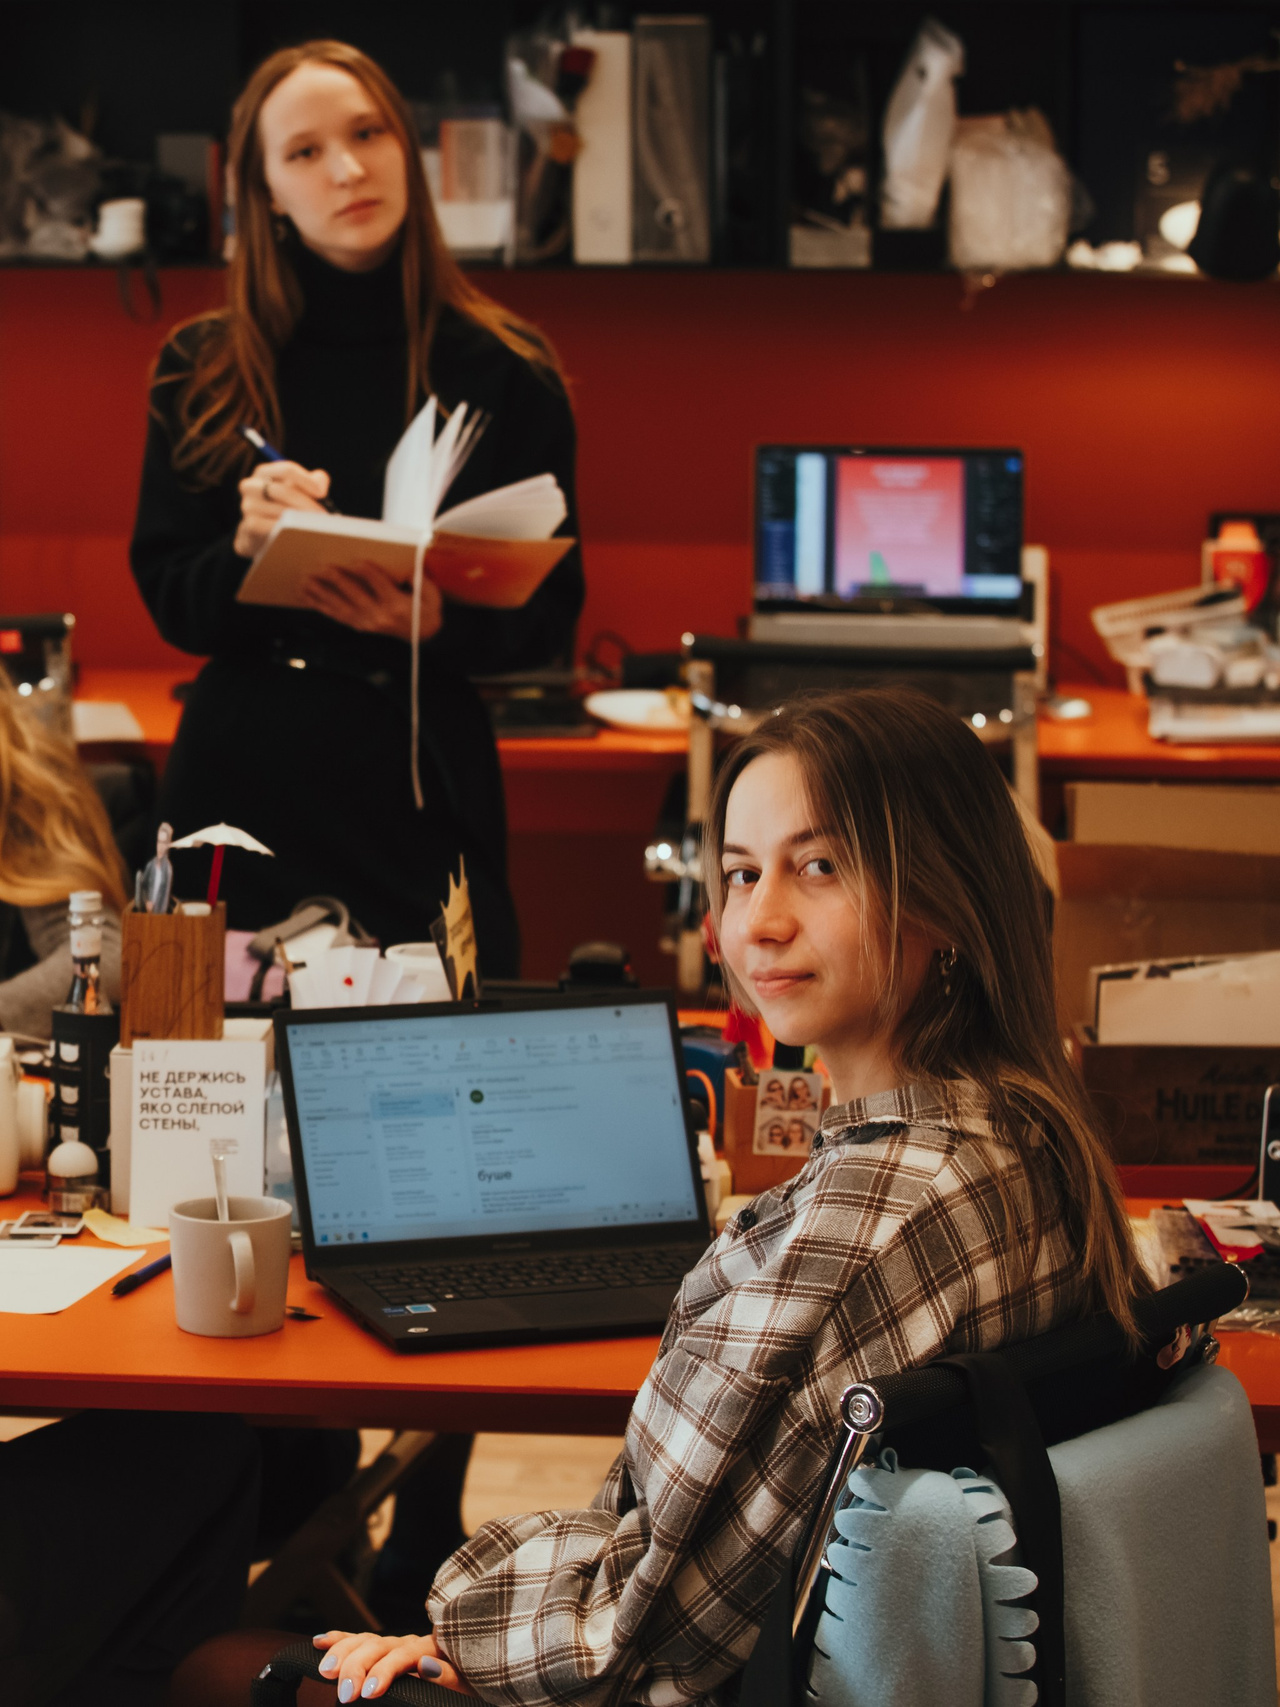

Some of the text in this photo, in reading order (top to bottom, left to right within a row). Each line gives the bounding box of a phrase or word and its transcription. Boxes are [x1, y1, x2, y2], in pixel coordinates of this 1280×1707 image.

[140, 1071, 246, 1085] НЕ ДЕРЖИСЬ
[140, 1087, 208, 1100] УСТАВА,
[139, 1100, 245, 1114] ЯКО СЛЕПОЙ
[1156, 1087, 1242, 1122] HUILE
[139, 1118, 200, 1131] СТЕНЫ,
[477, 1169, 512, 1183] буше
